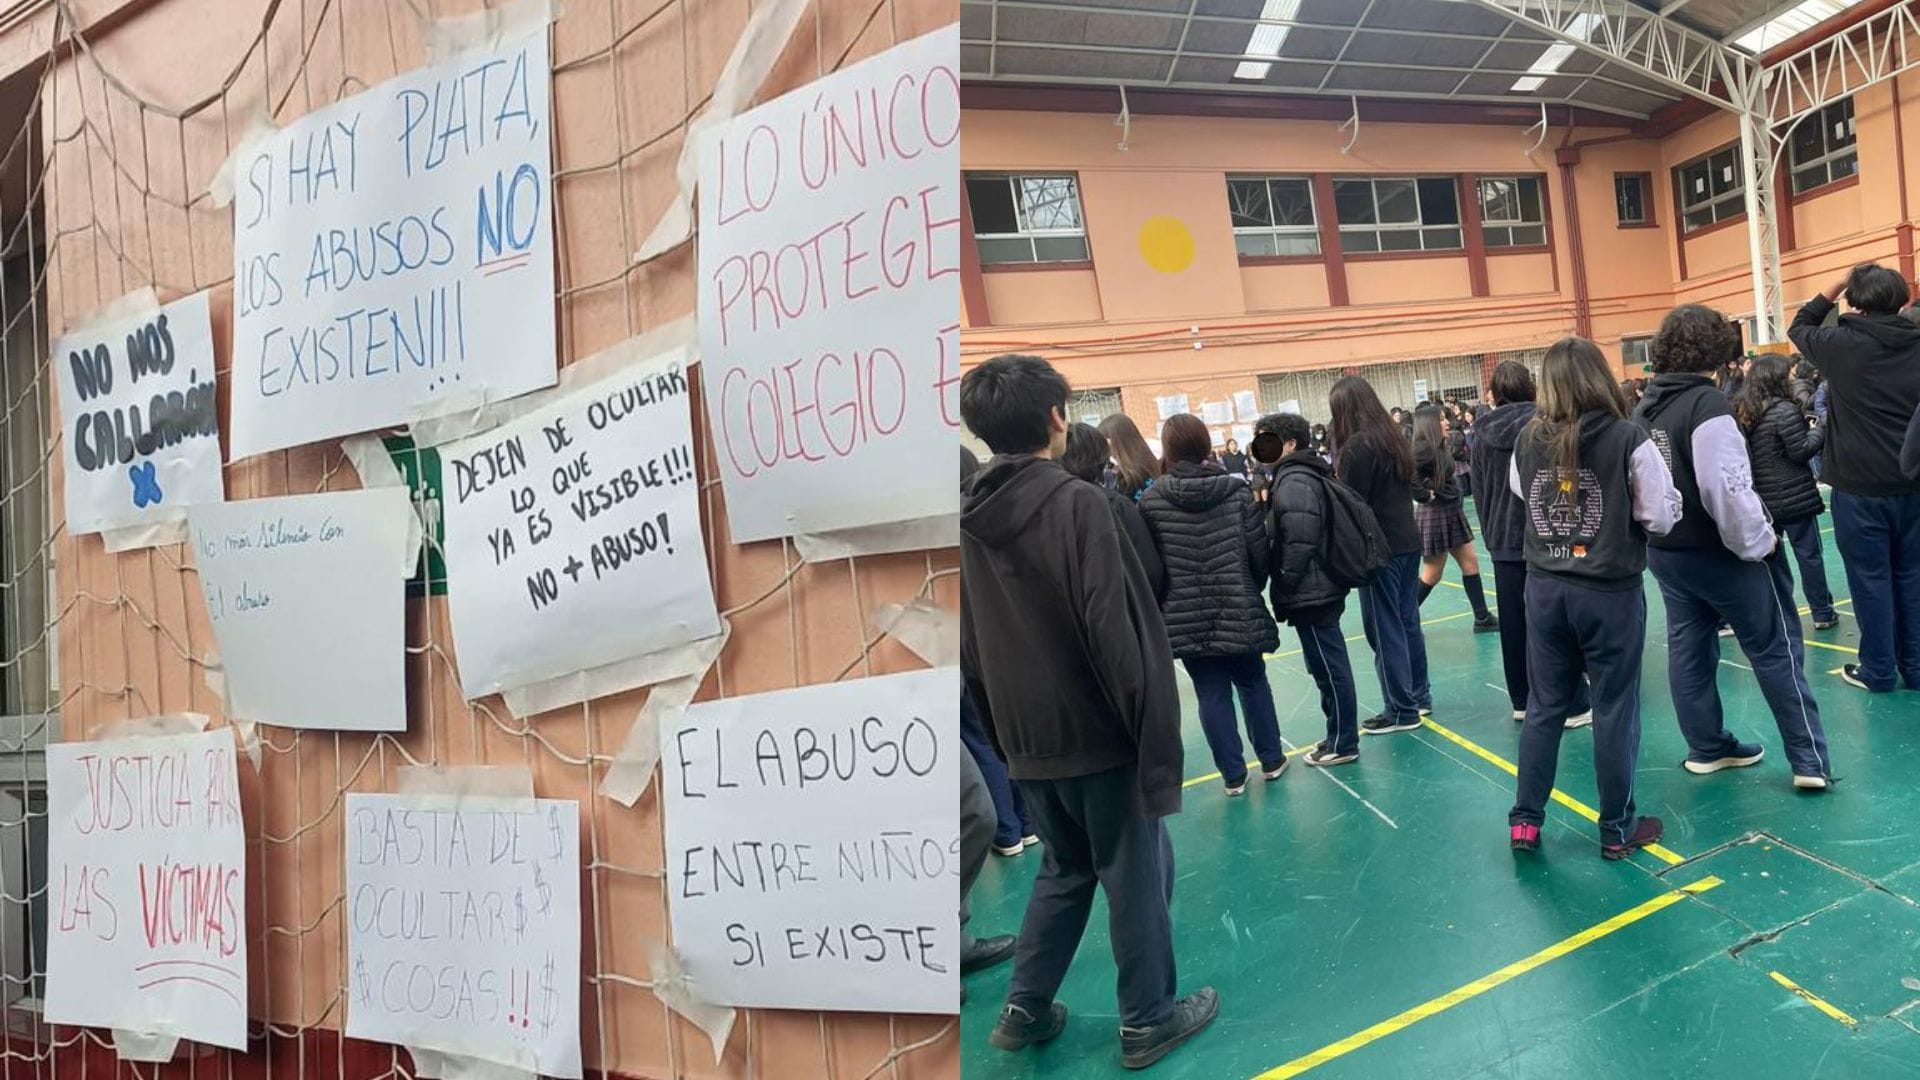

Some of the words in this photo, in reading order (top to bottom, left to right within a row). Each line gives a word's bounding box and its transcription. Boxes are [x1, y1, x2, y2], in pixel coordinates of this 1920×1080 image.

[247, 154, 273, 229] SI
[288, 113, 361, 207] HAY
[397, 53, 539, 178] PLATA,
[718, 125, 780, 226] LO
[802, 66, 959, 190] ÚNICO
[240, 252, 283, 317] LOS
[305, 207, 455, 298] ABUSOS
[476, 163, 541, 266] NO
[69, 343, 113, 402] NO
[126, 314, 175, 384] NOS
[452, 436, 526, 503] DEJEN
[543, 418, 573, 453] DE
[588, 370, 687, 430] OCULTAR
[721, 347, 906, 479] COLEGIO
[510, 487, 535, 514] LO
[552, 451, 592, 495] QUE
[488, 527, 515, 566] YA
[527, 508, 552, 545] ES
[526, 567, 558, 611] NO
[591, 512, 675, 580] ABUSO!
[755, 717, 938, 788] ABUSO
[74, 753, 192, 834] JUSTICIA
[354, 807, 471, 866] BASTA
[490, 810, 527, 864] DE
[683, 842, 816, 898] ENTRE
[60, 864, 118, 941] LAS
[726, 923, 764, 967] SI
[786, 924, 947, 972] EXISTE
